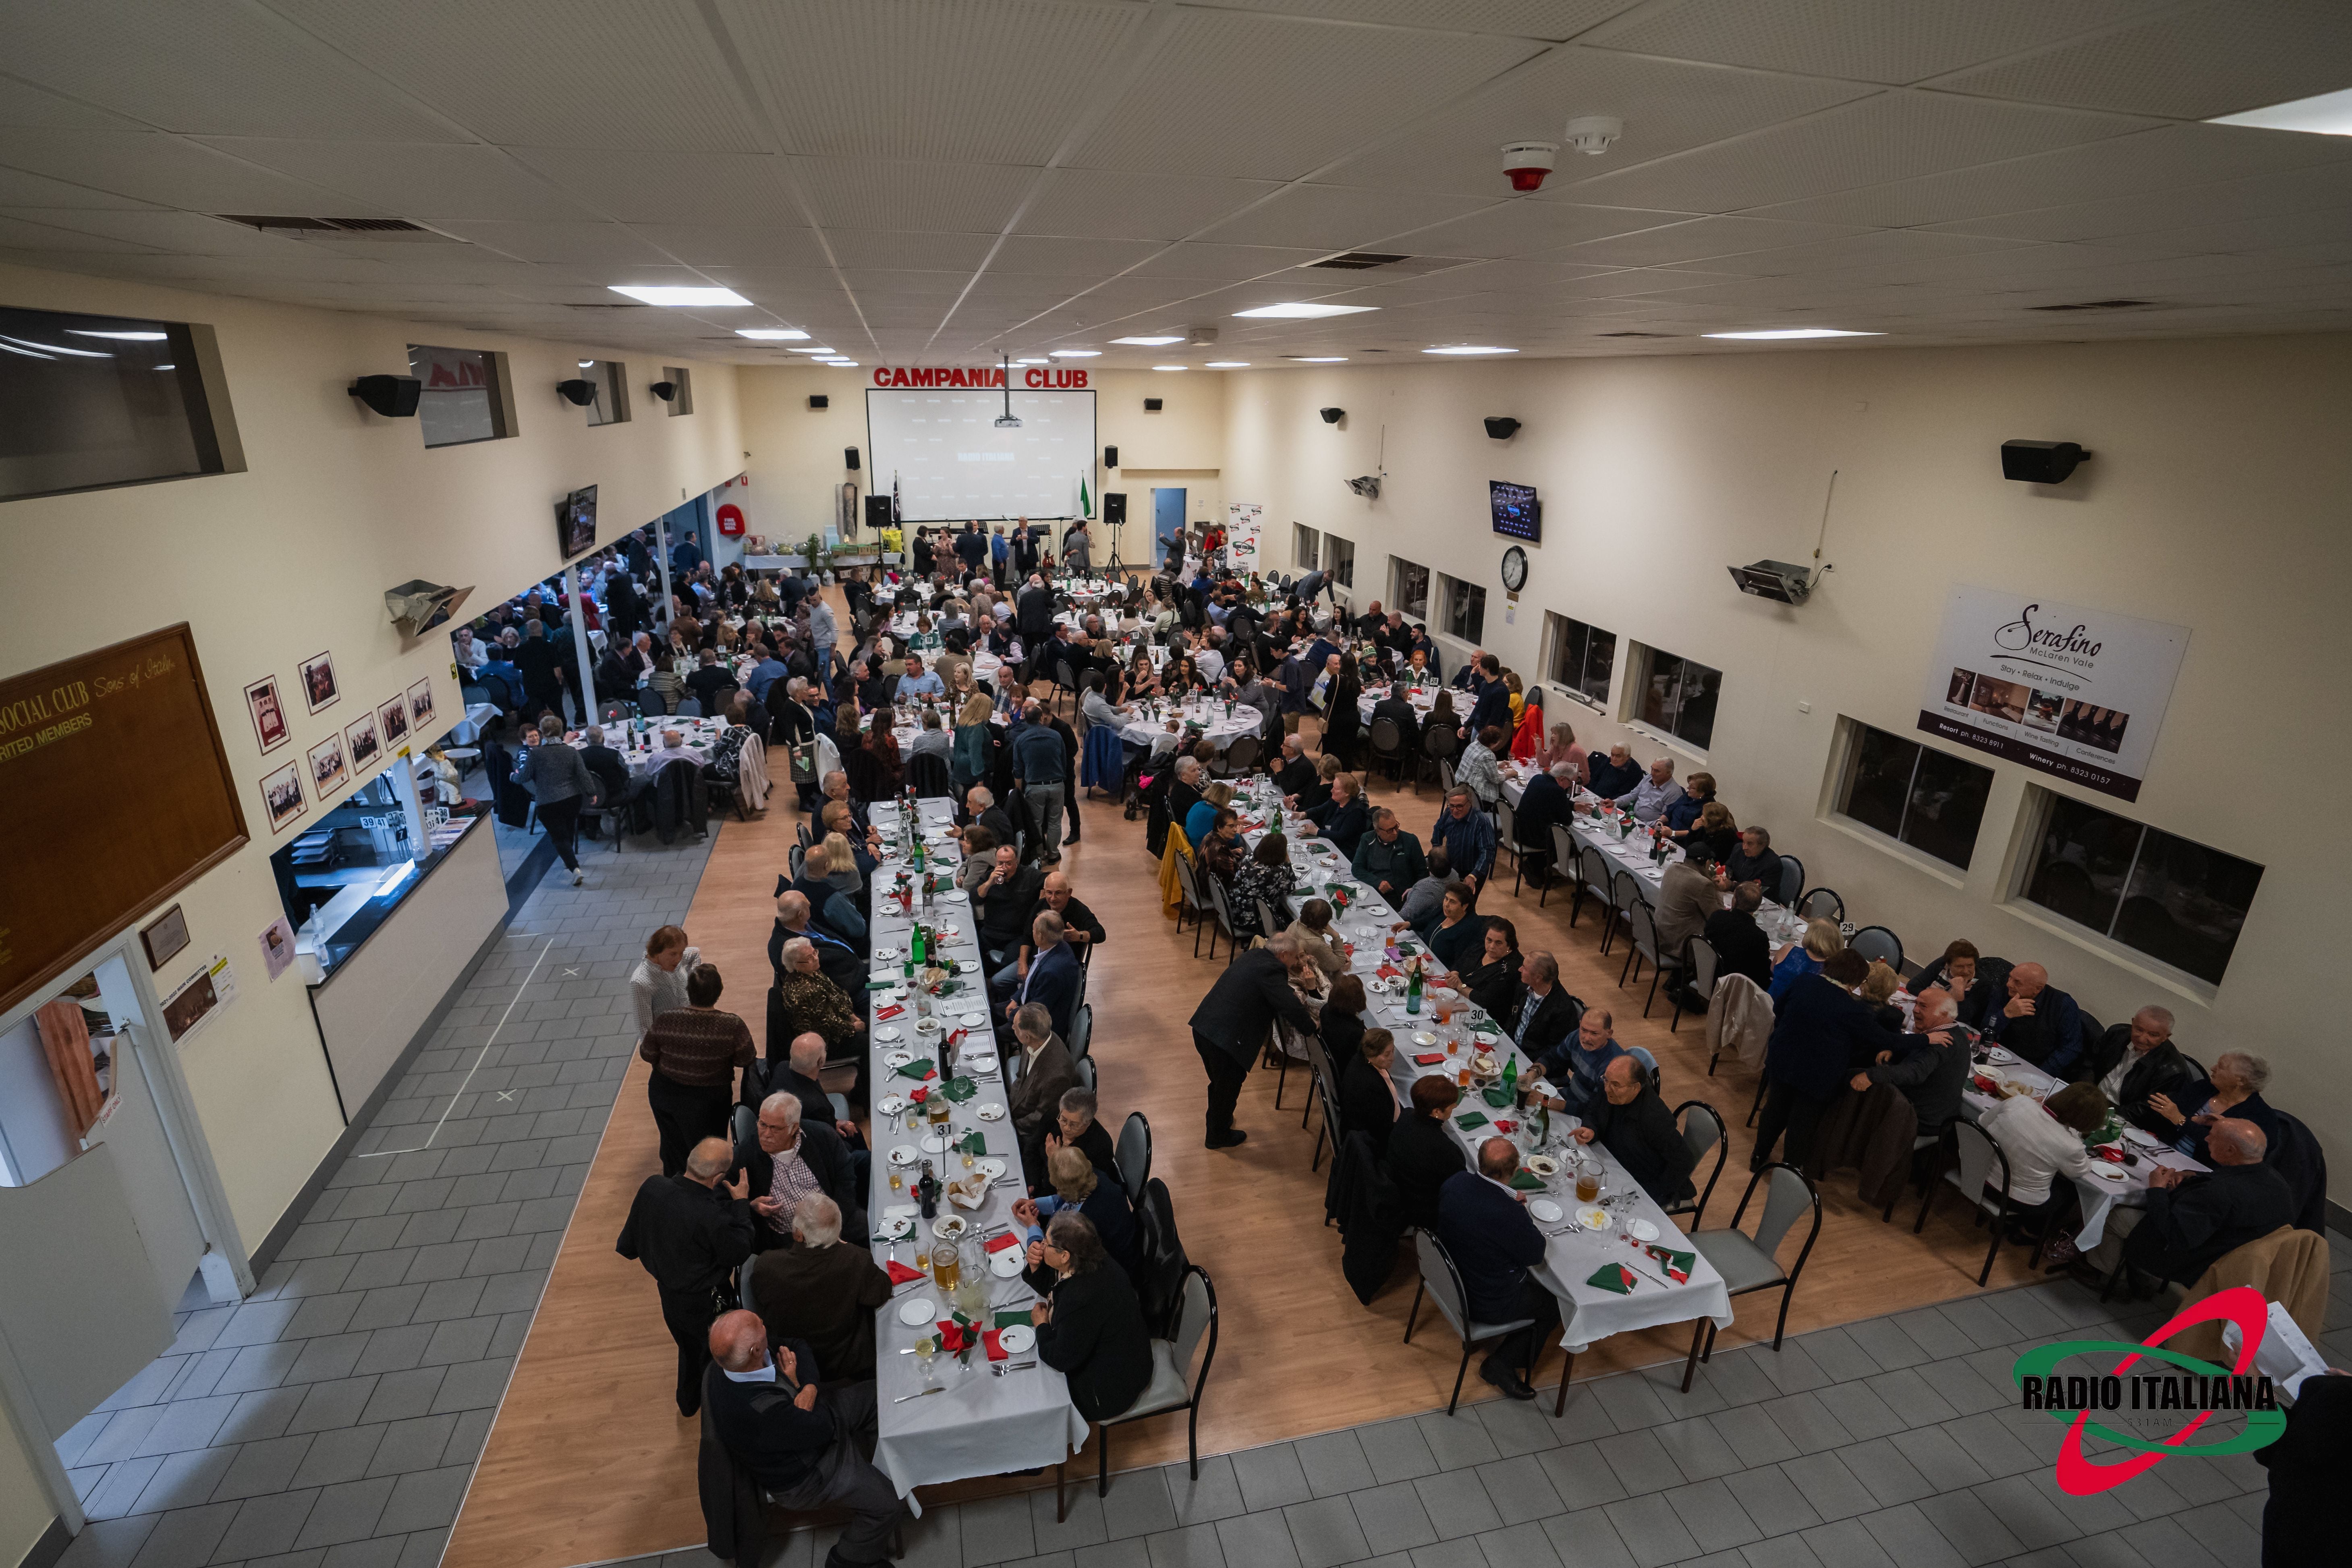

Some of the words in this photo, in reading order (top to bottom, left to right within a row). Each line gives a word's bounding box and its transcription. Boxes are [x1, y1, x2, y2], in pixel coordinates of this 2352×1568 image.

[873, 367, 1006, 387] CAMPANIA
[1025, 369, 1088, 388] CLUB
[1995, 604, 2102, 657] Serafino
[2030, 647, 2069, 663] McLaren
[2073, 657, 2094, 668] Vale
[52, 681, 89, 712] CLUB
[93, 677, 124, 698] Sons
[130, 664, 139, 689] of
[145, 654, 171, 679] Italy
[2000, 664, 2016, 676] Stay
[2022, 670, 2043, 682] Relax
[2049, 677, 2080, 692] Indulge
[35, 712, 92, 745] MEMBERS
[1944, 706, 1969, 718] Restaurant
[1983, 718, 2008, 731] Functions
[2024, 731, 2039, 740] Wine
[2039, 735, 2059, 747] Tasting
[2076, 748, 2116, 765] Conferences
[1939, 723, 1959, 734] Resort
[1960, 729, 1970, 739] ph.
[1972, 733, 1988, 744] 8323
[1989, 738, 2004, 749] 8911
[2029, 753, 2054, 767] Winery
[2056, 762, 2068, 772] ph.
[2070, 766, 2089, 778] 8323
[2091, 773, 2110, 785] 0157
[388, 812, 397, 821] 37
[439, 808, 448, 816] 38
[1842, 923, 1853, 932] 29
[177, 981, 187, 992] MAIN
[186, 964, 207, 984] COMMITTEE
[1471, 1010, 1485, 1020] 30
[937, 1124, 951, 1135] 31
